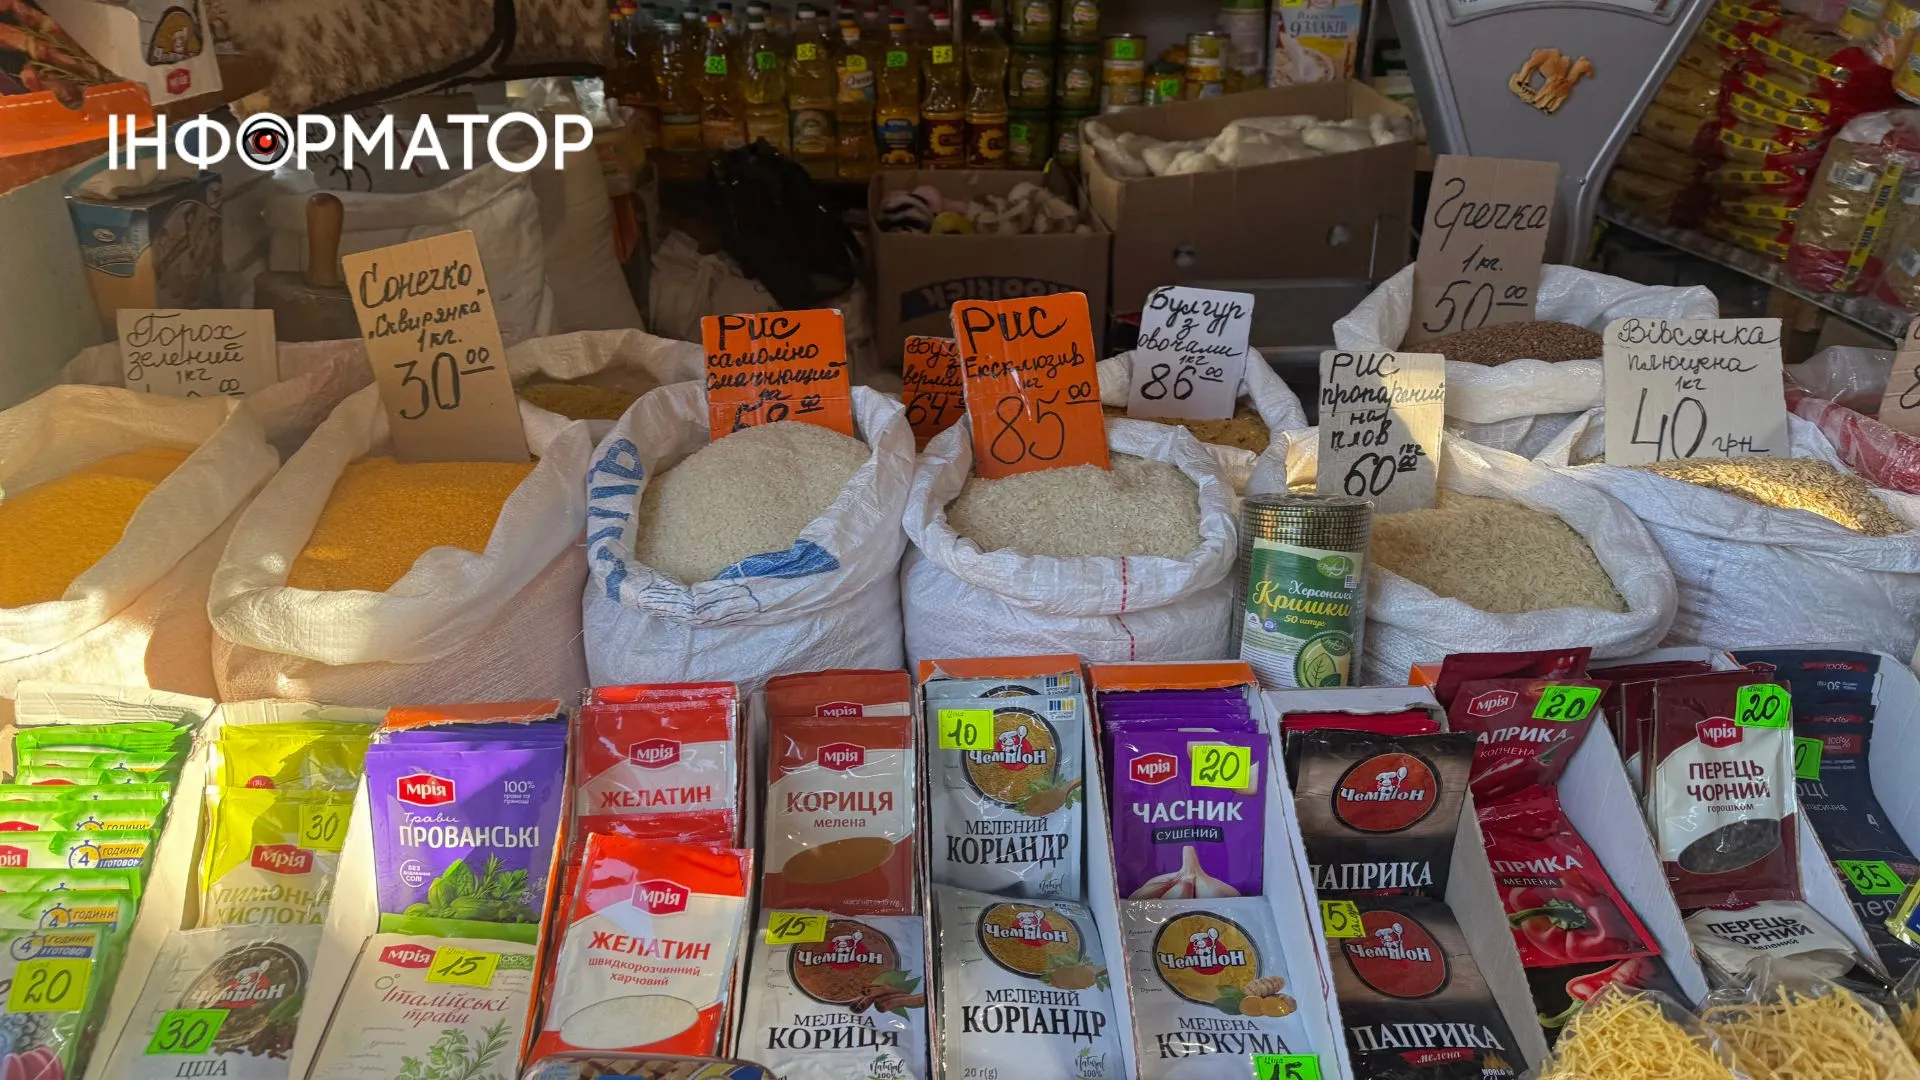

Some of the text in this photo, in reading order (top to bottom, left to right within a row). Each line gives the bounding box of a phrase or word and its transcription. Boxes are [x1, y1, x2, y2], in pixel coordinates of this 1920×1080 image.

[1434, 178, 1548, 251] Гречка
[359, 260, 472, 309] Сонечко
[1149, 286, 1246, 337] Булгур
[1422, 280, 1495, 332] 50
[126, 312, 247, 360] Горох
[1180, 317, 1199, 340] з
[1617, 318, 1780, 345] Вівсянка
[1628, 353, 1758, 376] плющена
[394, 352, 461, 419] 30
[1141, 363, 1196, 400] 86
[905, 392, 949, 426] 64
[990, 391, 1065, 464] 85
[1630, 387, 1708, 462] 40
[1343, 452, 1397, 497] 60
[1252, 580, 1352, 617] Кришки
[1544, 693, 1586, 719] 20
[1742, 693, 1781, 723] 20
[947, 718, 978, 747] 10
[1476, 726, 1568, 745] АПРИКА
[1199, 749, 1240, 783] 20
[1689, 760, 1765, 780] ПЕРЕЦЬ
[601, 785, 712, 808] ЖЕЛАТИН
[1687, 778, 1771, 802] ЧОРНИЙ
[787, 791, 893, 816] КОРИЦЯ
[1132, 799, 1243, 824] ЧАСНИК
[305, 812, 340, 842] 30
[813, 818, 867, 829] мелена
[965, 816, 1049, 836] МЕЛЕНИЙ
[1156, 828, 1218, 842] СУШЕНИЙ
[400, 825, 540, 849] ПРОВАНСЬКІ
[946, 833, 1069, 870] КОРІАНДР
[1502, 877, 1558, 887] МЕЛЕНА
[1851, 864, 1891, 890] 35
[772, 916, 817, 939] 15
[1706, 915, 1798, 936] ПЕРЕЦЬ
[588, 931, 711, 961] ЖЕЛАТИН
[436, 956, 486, 977] 15
[588, 957, 701, 977] швидкорозчинний
[610, 972, 669, 987] харчовий
[23, 968, 72, 1004] 20
[381, 986, 511, 1011] Італійські
[985, 988, 1081, 1007] МЕЛЕНИЙ
[402, 1007, 470, 1029] трави
[793, 1013, 876, 1028] МЕЛЕНА
[962, 1005, 1107, 1044] КОРІАНДР
[1177, 1016, 1260, 1031] МЕЛЕНА
[159, 1018, 209, 1050] 30
[766, 1026, 901, 1052] КОРИЦЯ
[1155, 1031, 1293, 1059] КУРКУМА
[1349, 1022, 1505, 1051] ПАПРИКА
[1416, 1051, 1462, 1065] мелена
